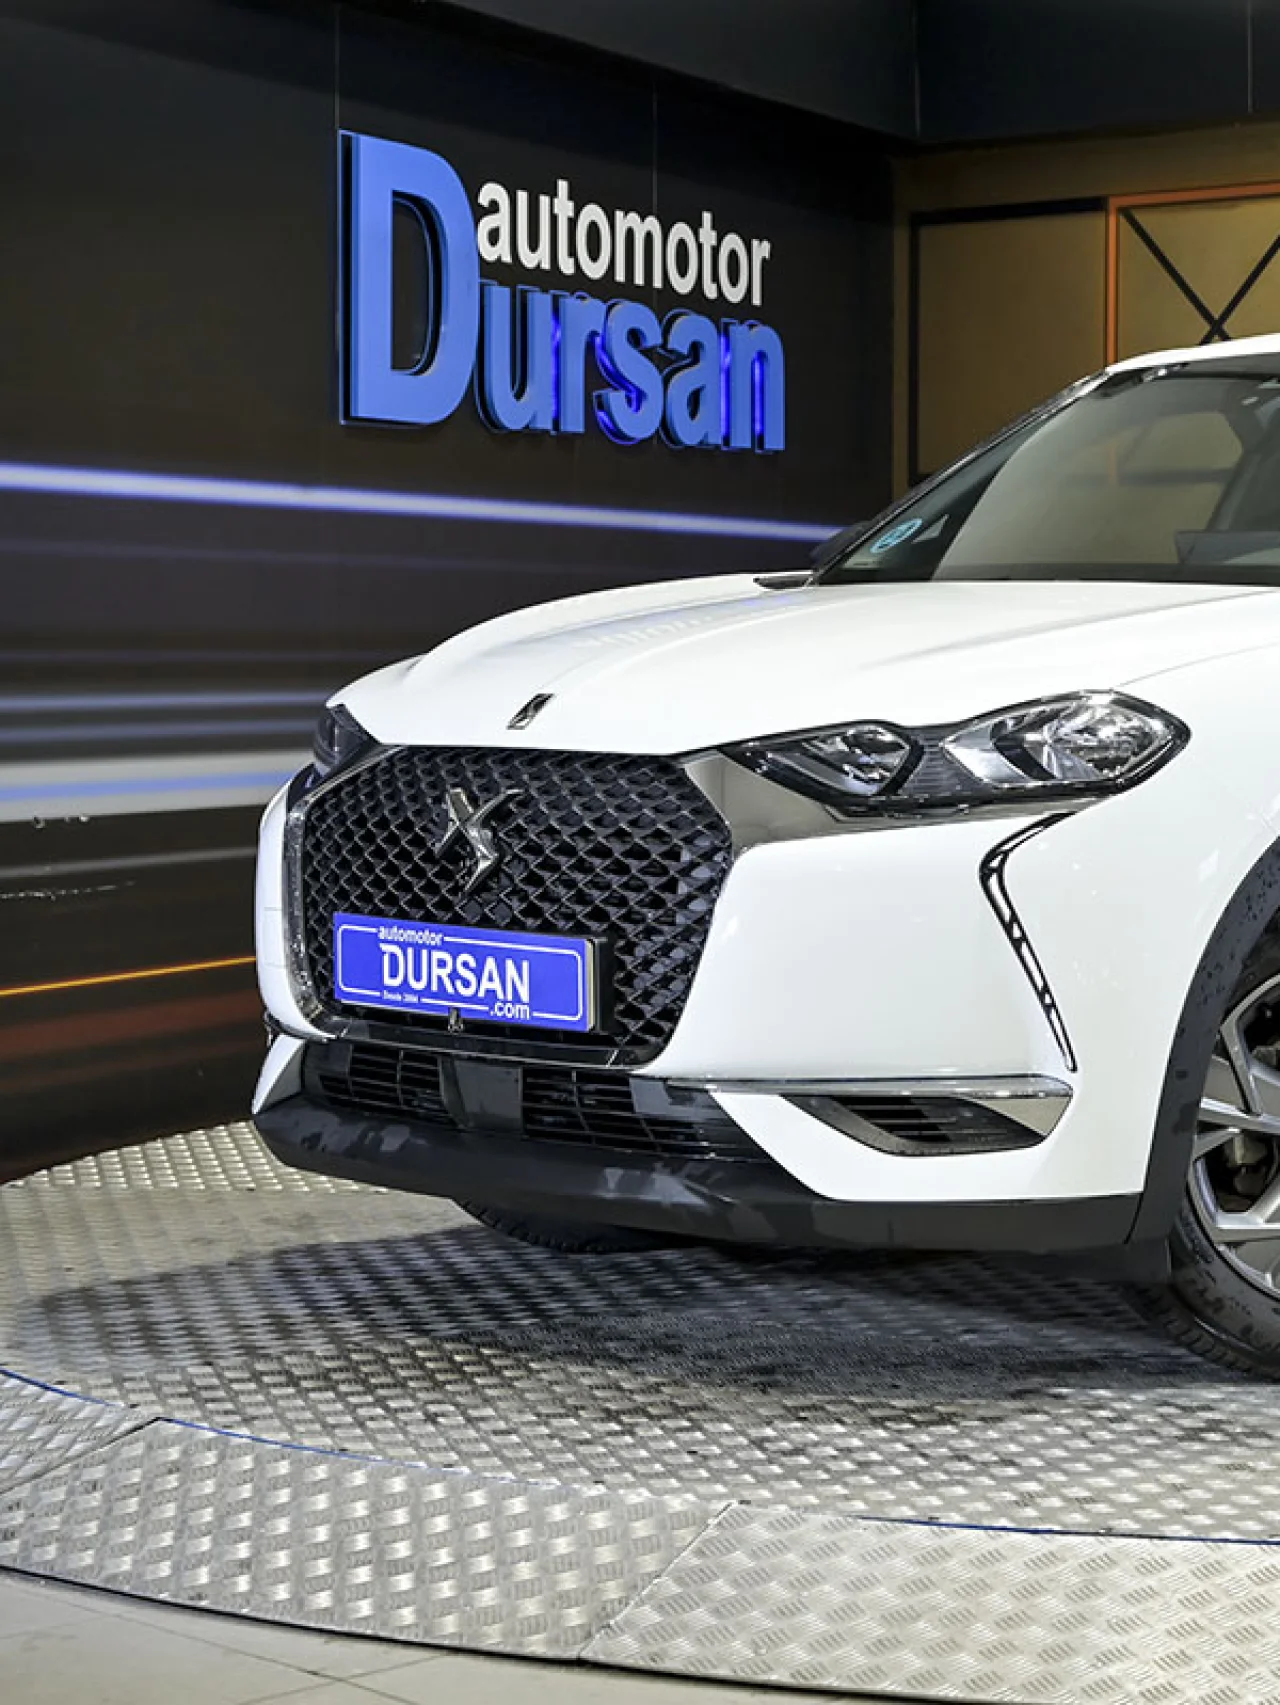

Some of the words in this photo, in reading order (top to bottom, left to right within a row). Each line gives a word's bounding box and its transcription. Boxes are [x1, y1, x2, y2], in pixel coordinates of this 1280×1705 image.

[478, 178, 771, 306] automotor
[339, 130, 786, 454] Dursan
[378, 925, 443, 946] automotor
[378, 943, 530, 1004] DURSAN
[490, 1001, 530, 1020] .com
